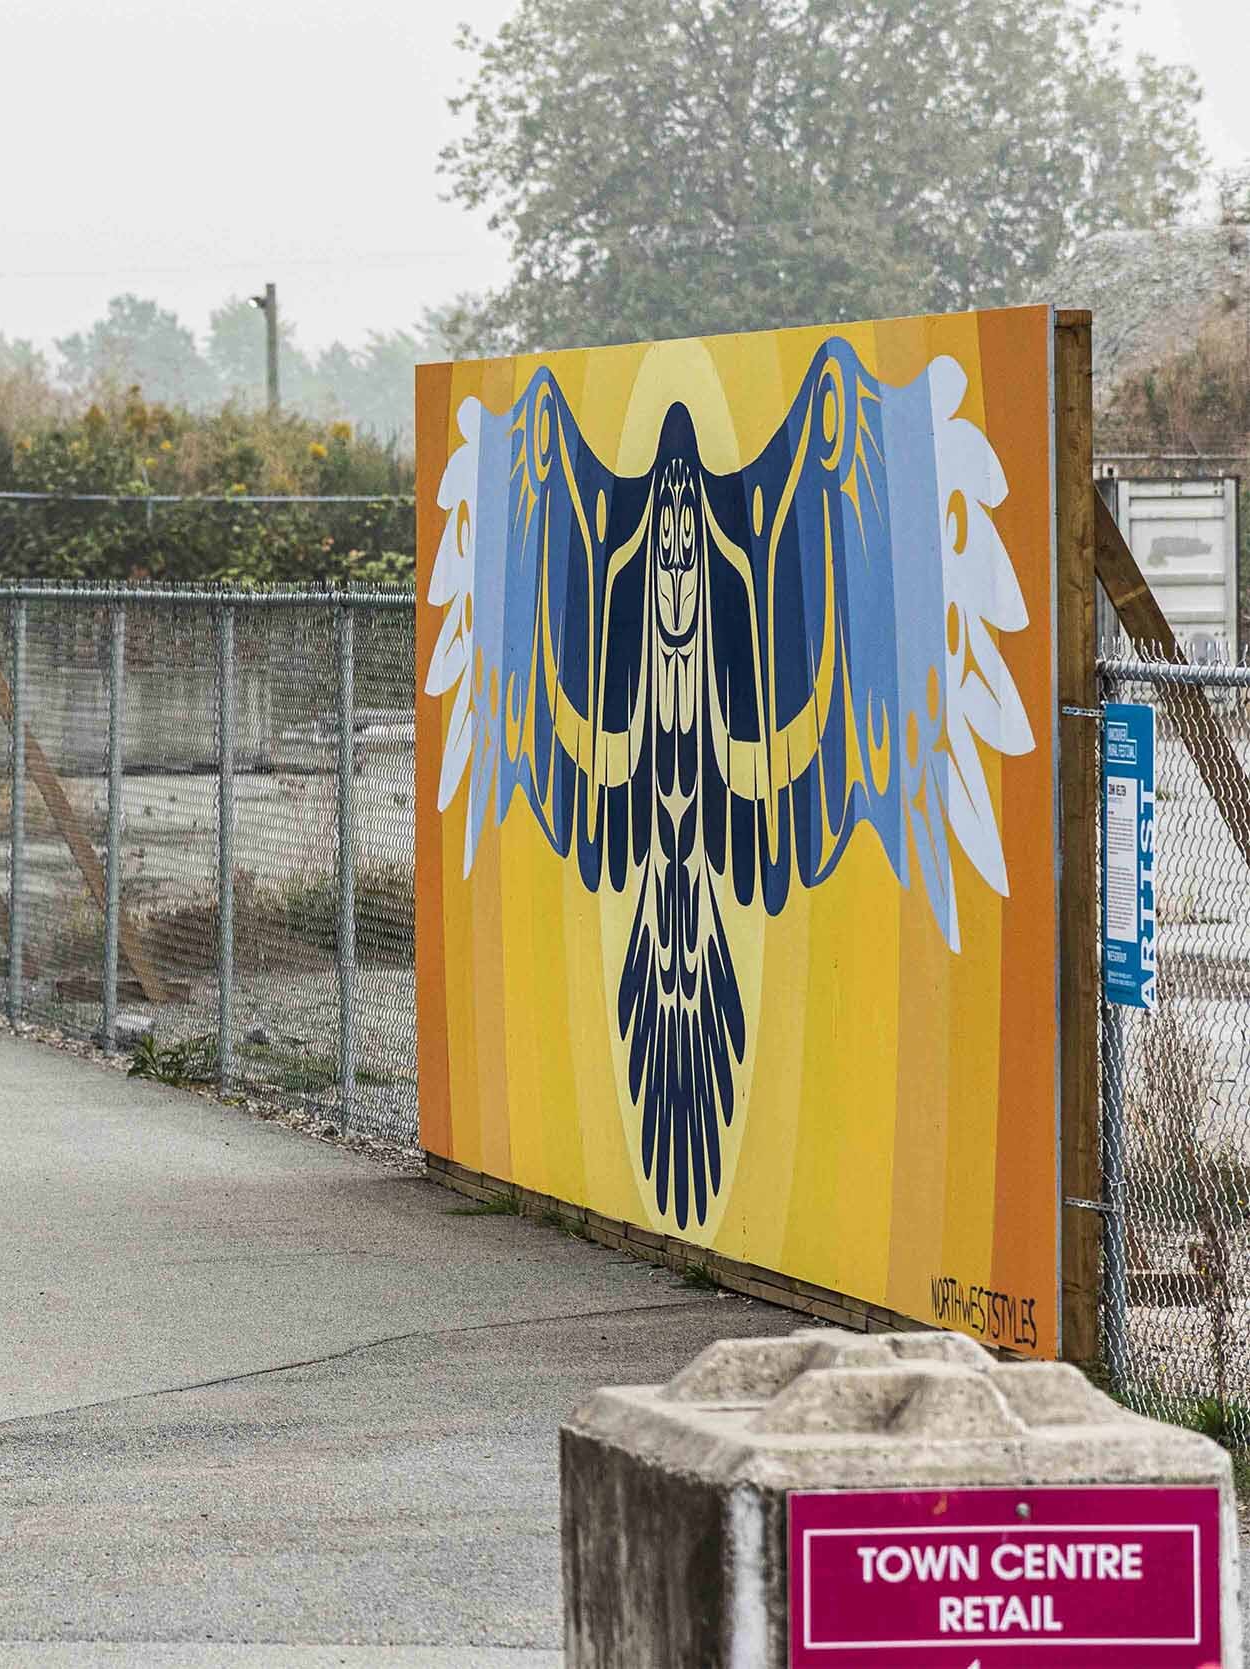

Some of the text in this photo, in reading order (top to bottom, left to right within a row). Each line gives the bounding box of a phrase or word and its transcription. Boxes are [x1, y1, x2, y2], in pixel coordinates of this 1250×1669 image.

[1140, 778, 1156, 1011] ARTIST
[931, 1275, 1037, 1349] NORTHWESTSTYLES
[857, 1543, 1143, 1583] TOWN CENTRE
[939, 1595, 1063, 1632] RETAIL
